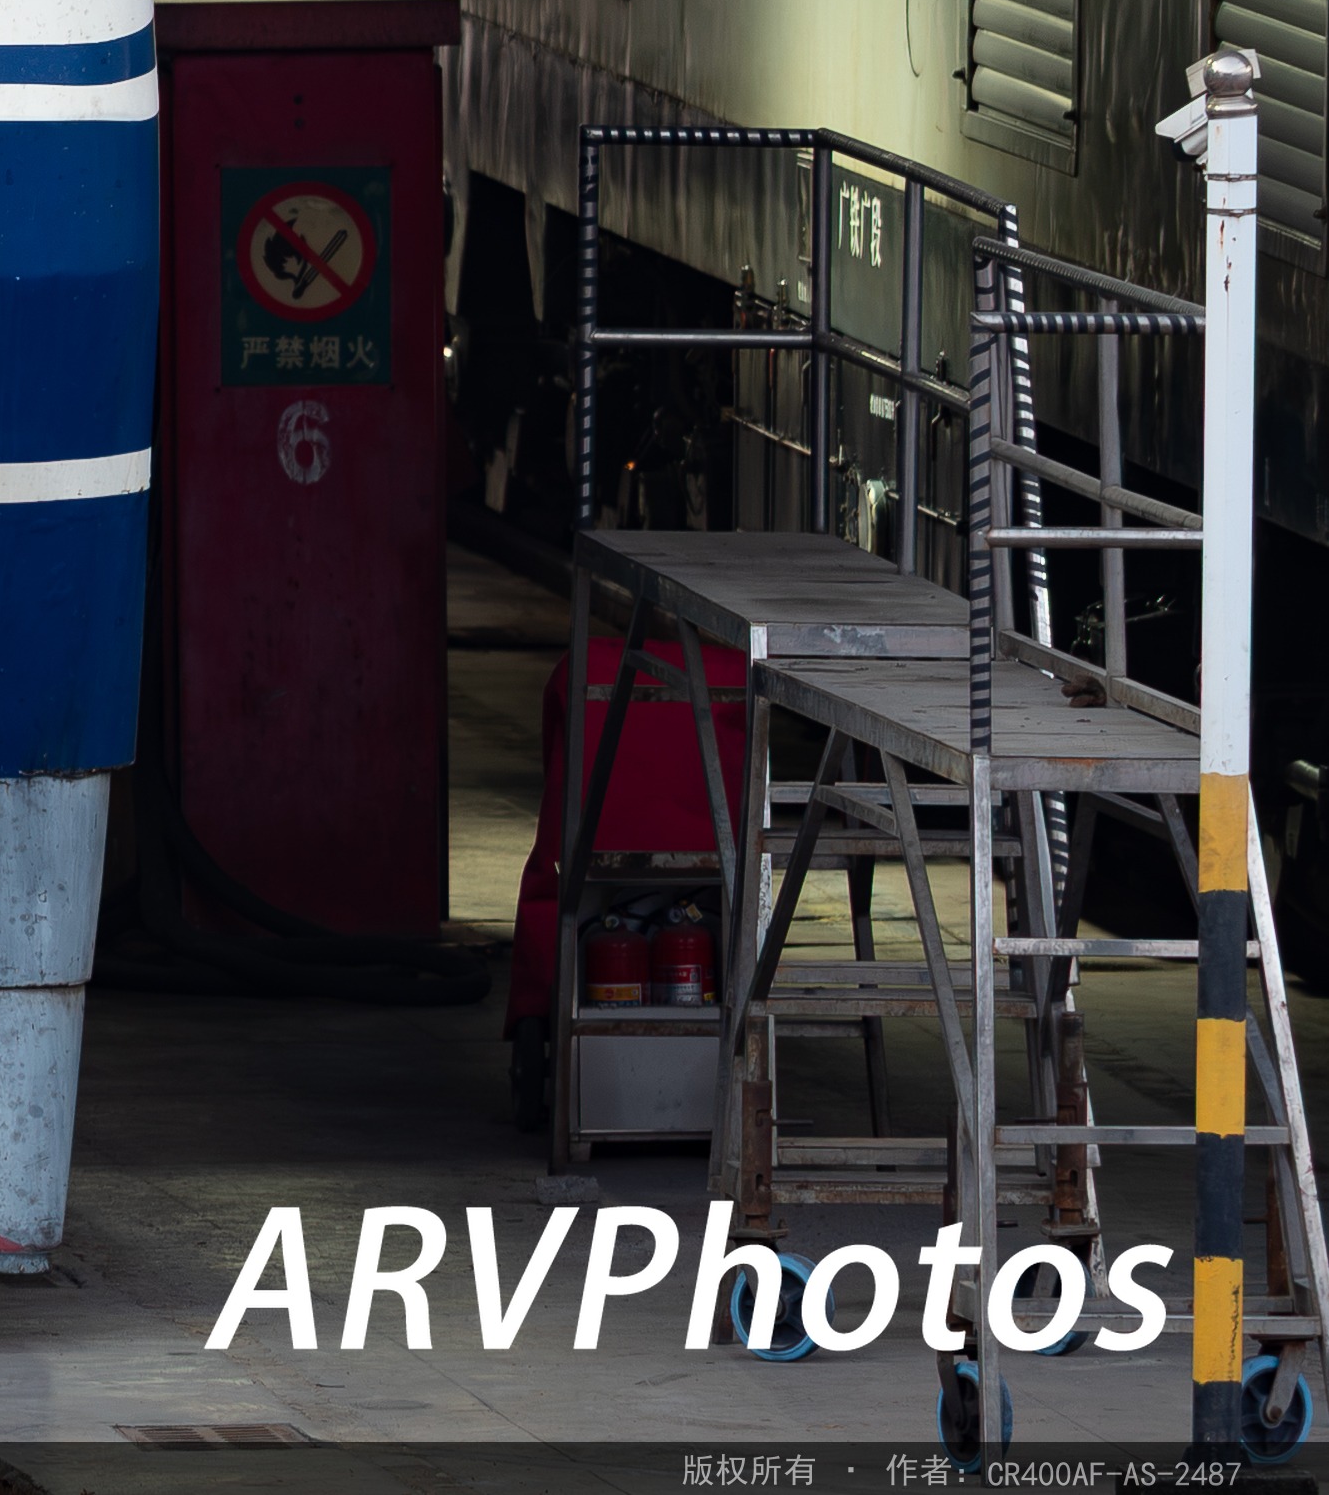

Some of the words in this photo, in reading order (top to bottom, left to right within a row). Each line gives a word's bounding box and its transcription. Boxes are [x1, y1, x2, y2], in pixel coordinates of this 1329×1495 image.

[241, 334, 375, 372] 严禁烟火
[276, 398, 332, 486] 6
